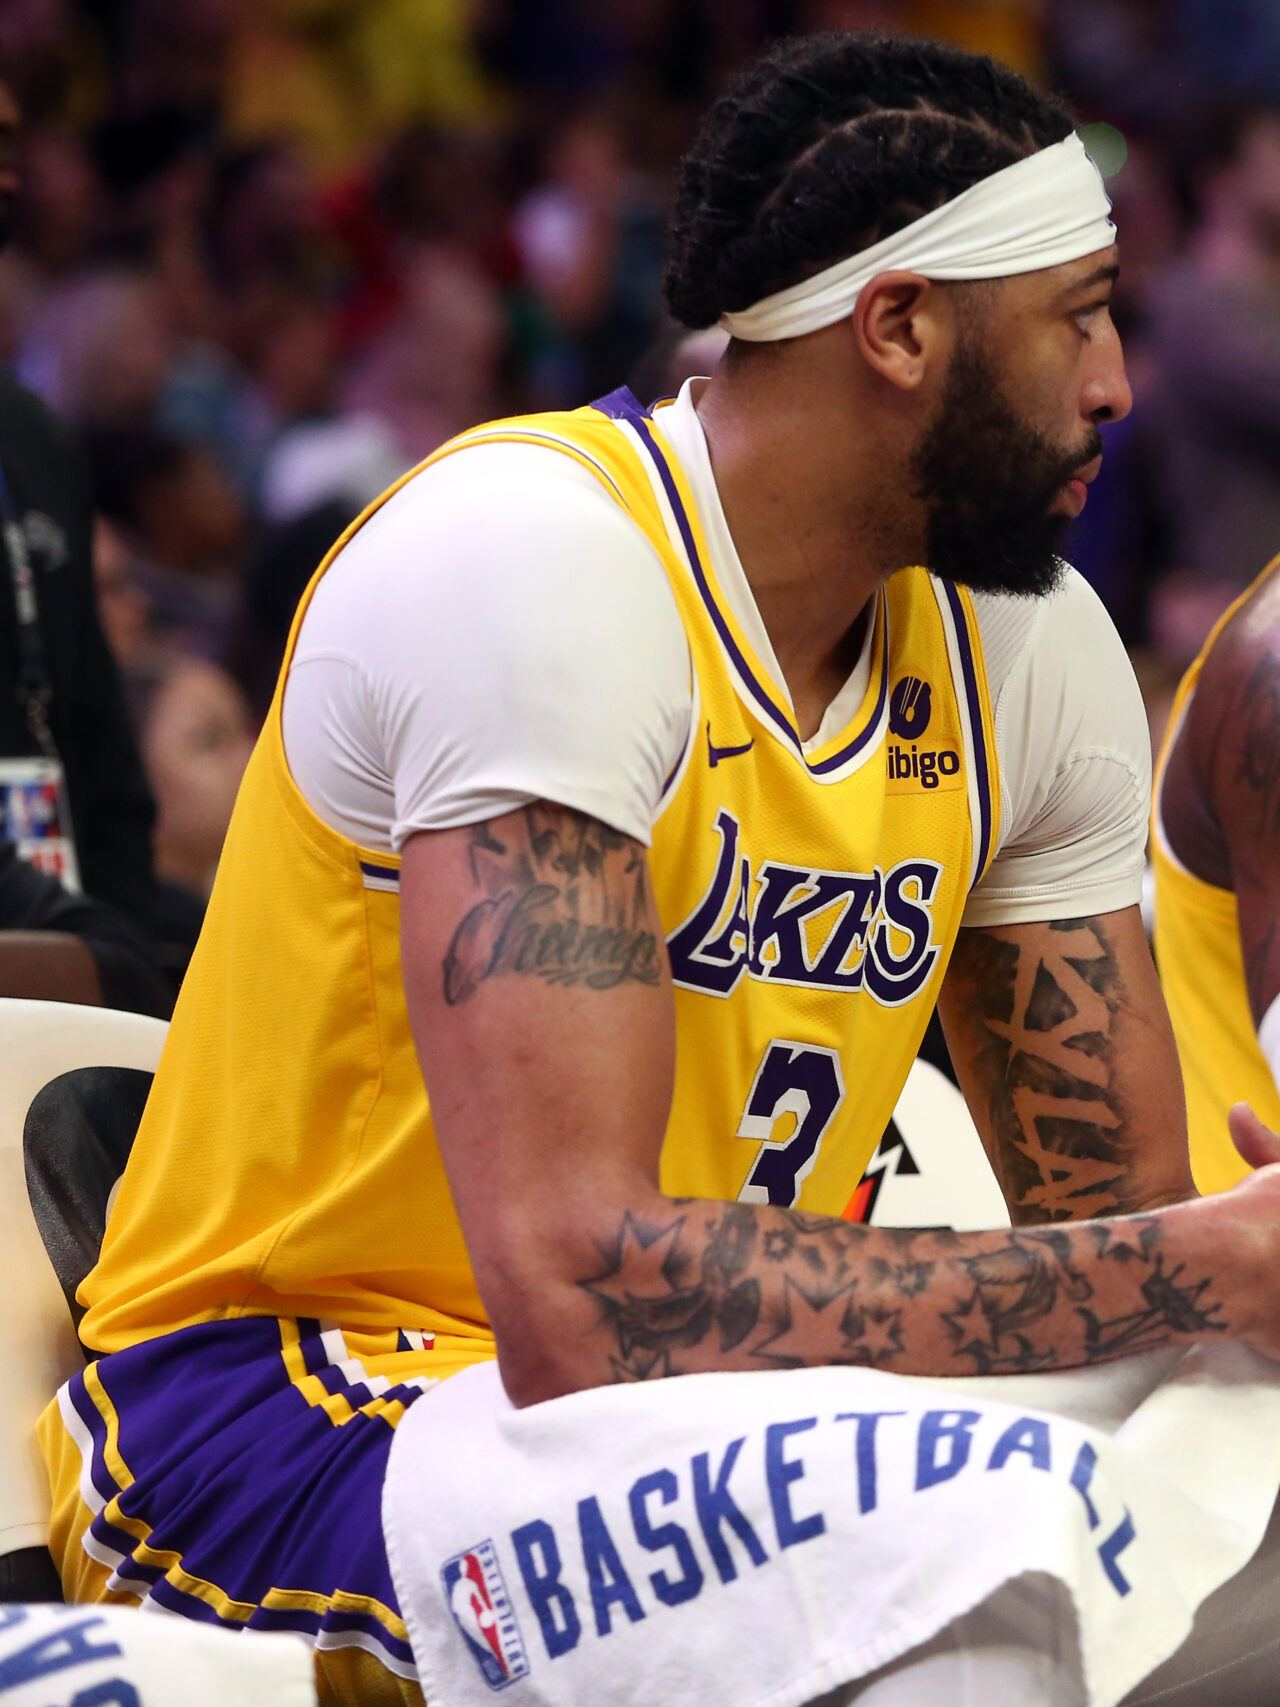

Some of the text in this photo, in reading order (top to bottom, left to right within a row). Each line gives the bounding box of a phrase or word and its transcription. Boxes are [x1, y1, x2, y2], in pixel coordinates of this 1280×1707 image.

[886, 744, 960, 789] ibigo
[666, 807, 944, 1008] LAKES
[736, 1039, 846, 1208] 3
[512, 1409, 1135, 1658] BASKETBALL
